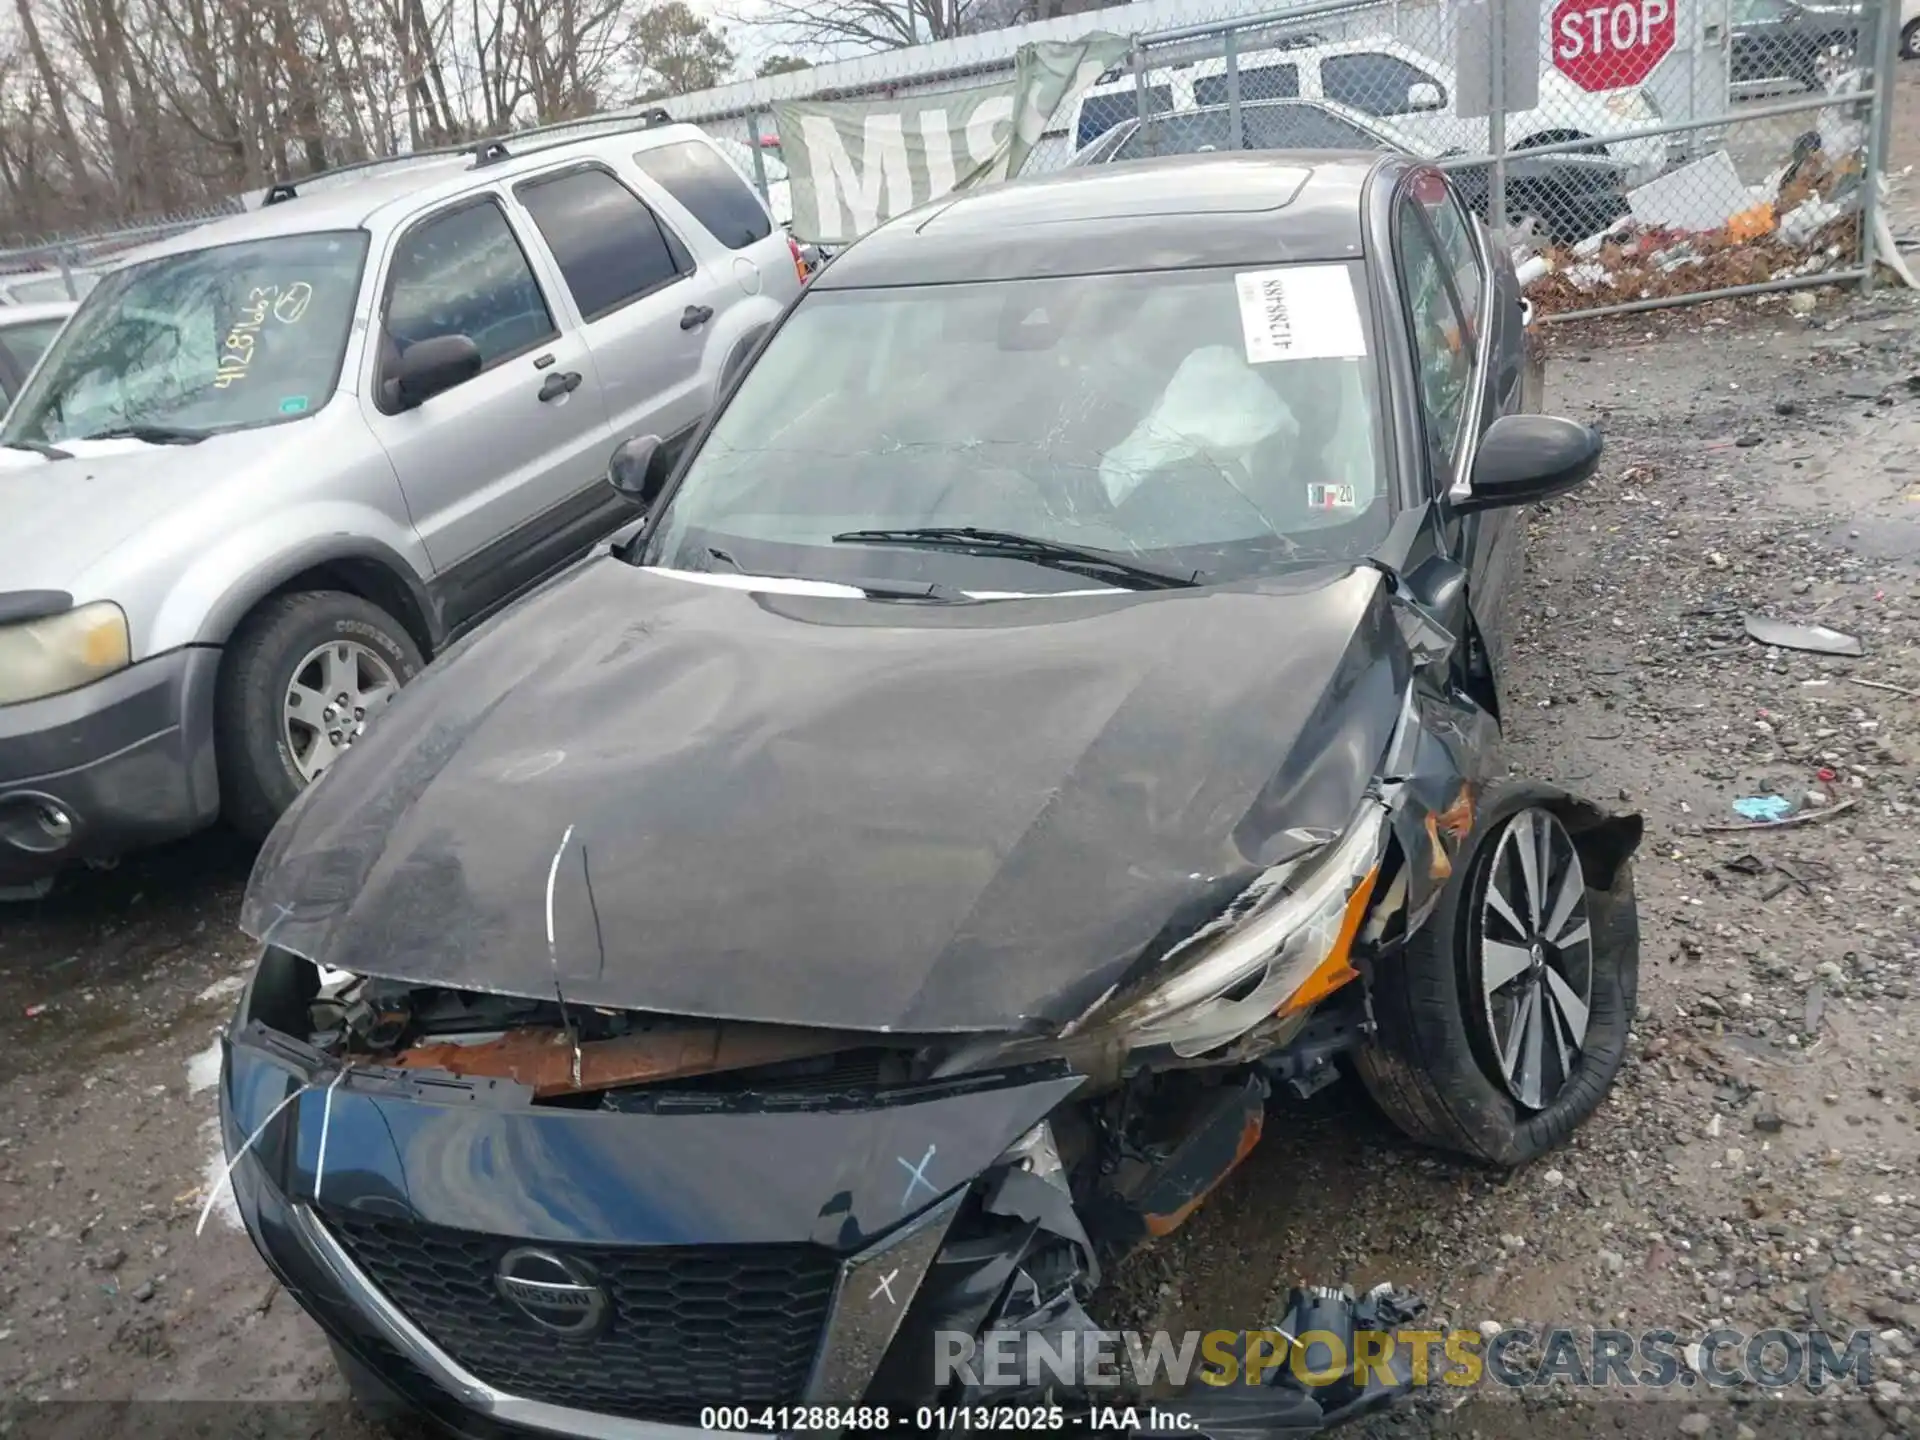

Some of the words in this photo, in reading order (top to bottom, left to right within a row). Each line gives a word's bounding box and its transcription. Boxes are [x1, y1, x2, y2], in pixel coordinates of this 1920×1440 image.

[1559, 0, 1669, 59] STOP
[1261, 279, 1292, 350] 41288488
[506, 1282, 592, 1306] NISSAN
